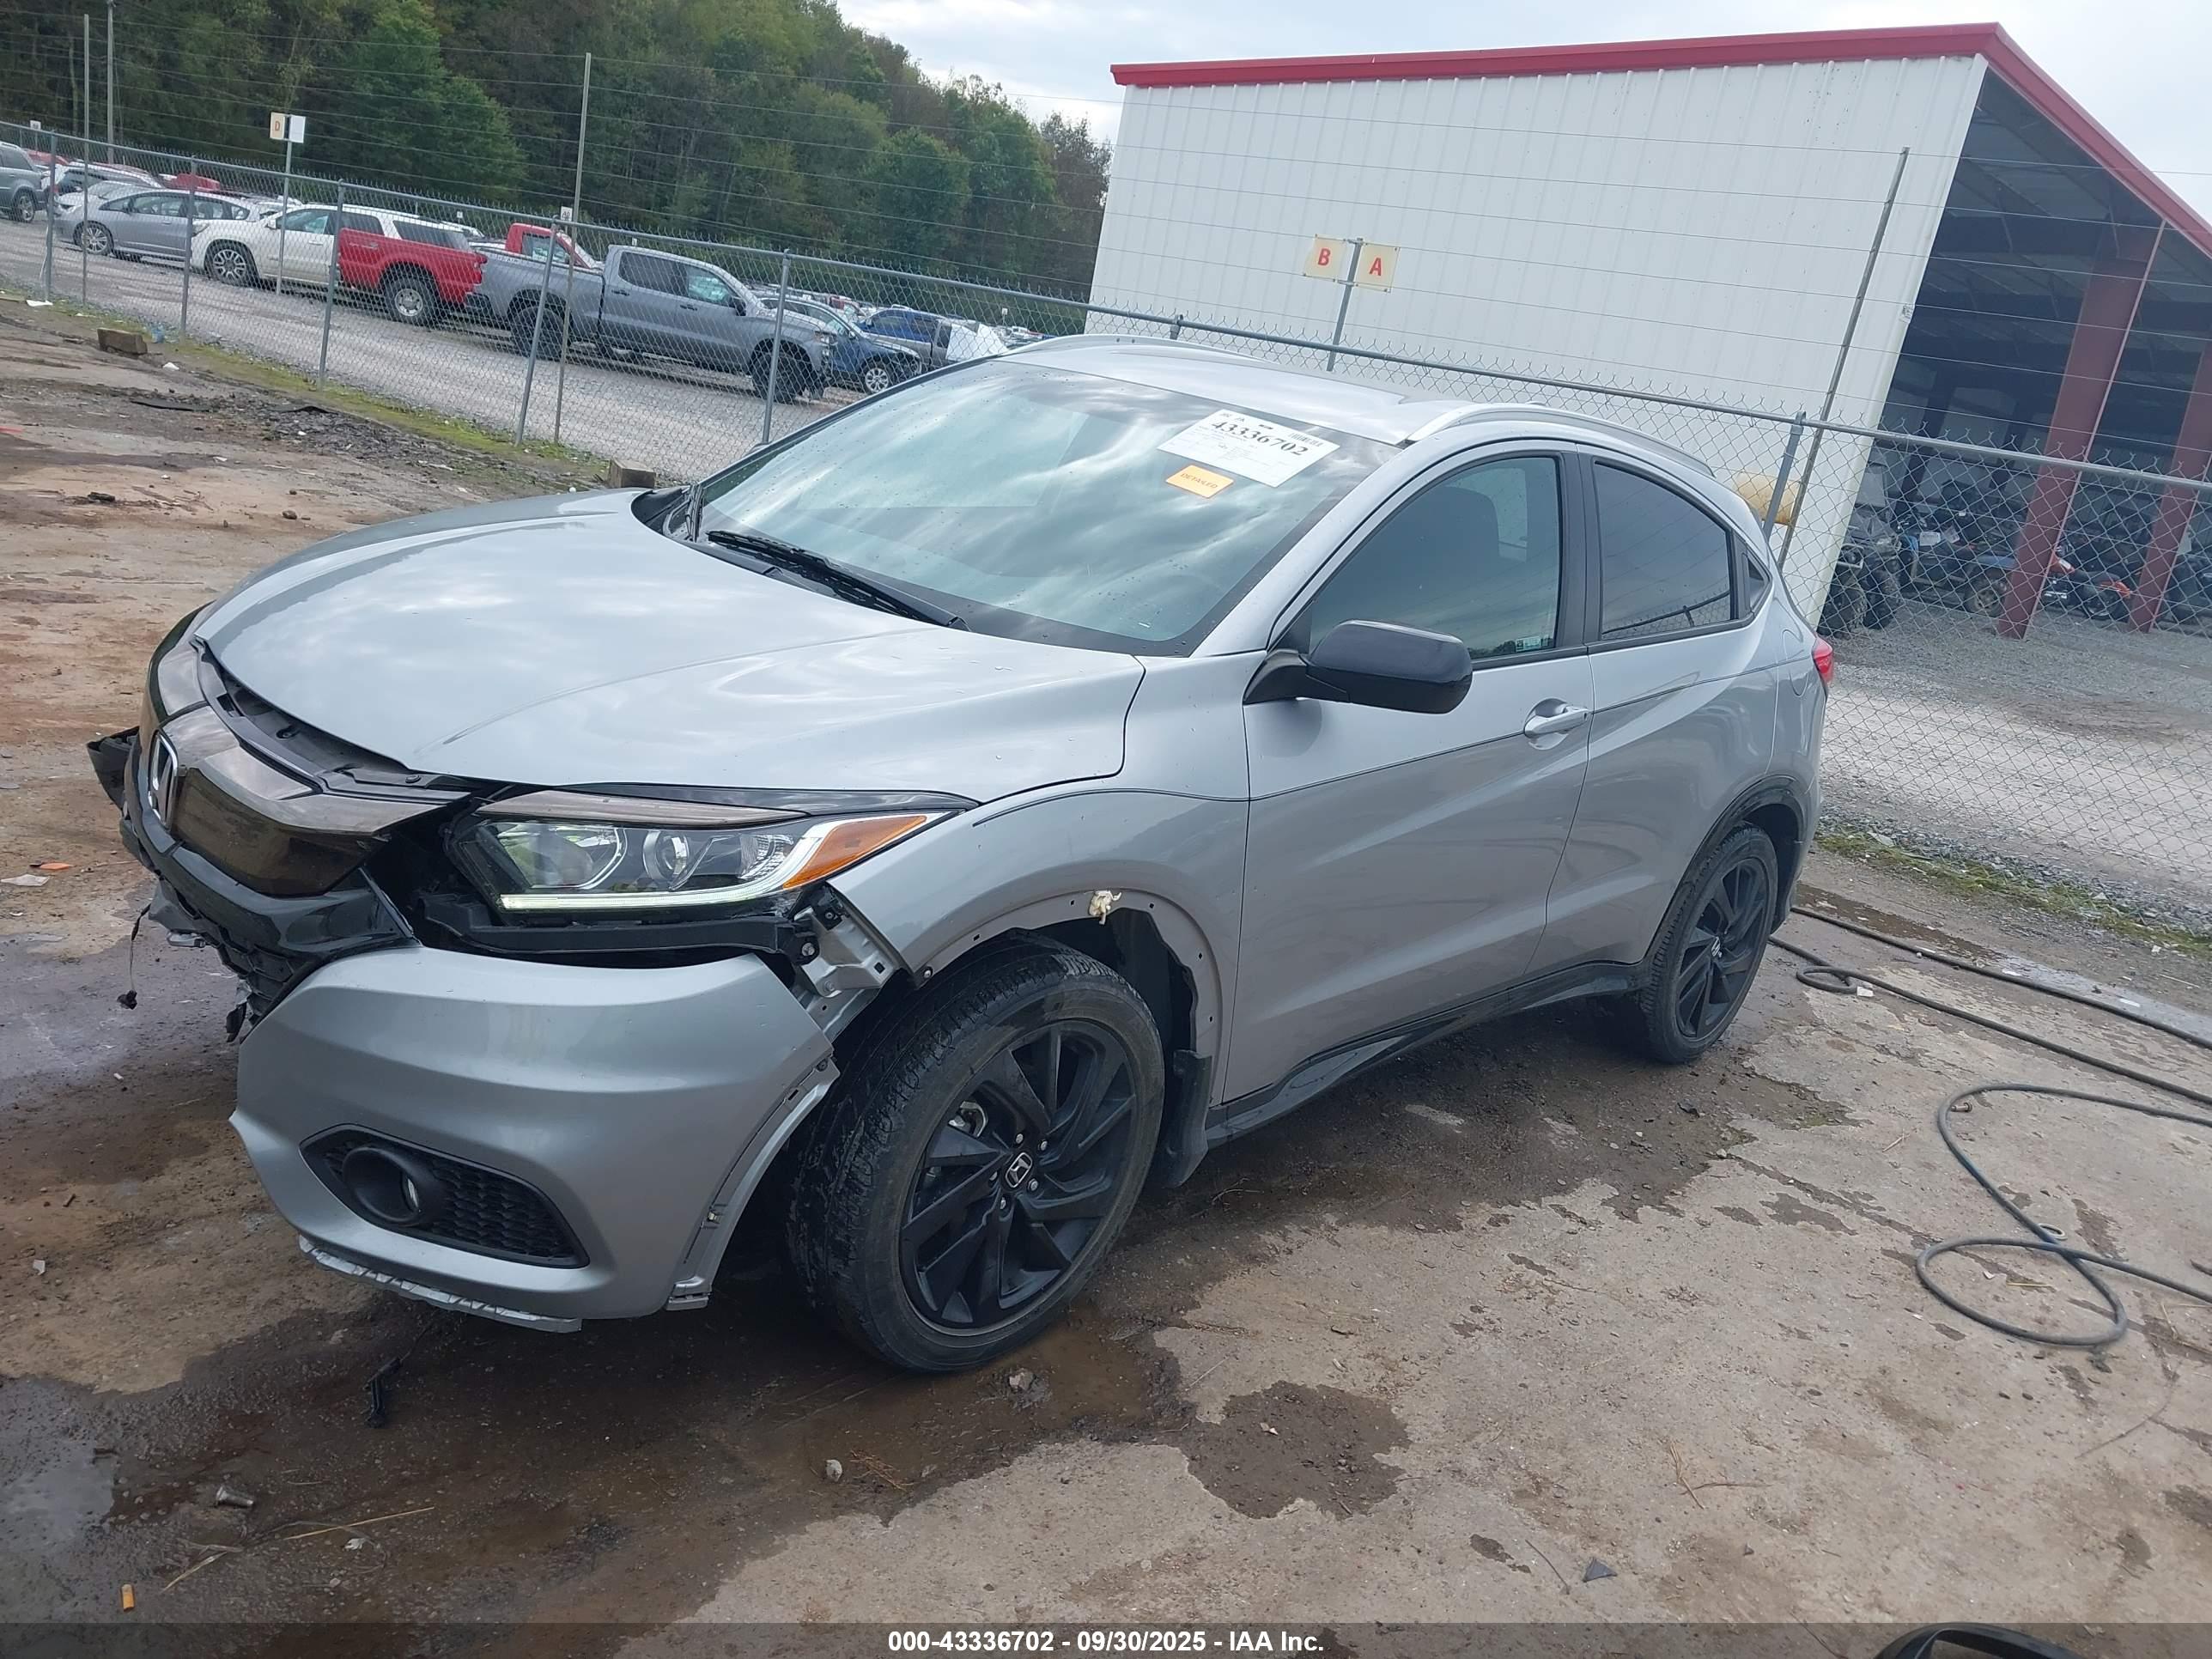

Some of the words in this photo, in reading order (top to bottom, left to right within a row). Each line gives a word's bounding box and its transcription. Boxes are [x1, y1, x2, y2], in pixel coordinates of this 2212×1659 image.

[274, 120, 281, 131] D
[1317, 247, 1332, 266] B
[1369, 257, 1382, 276] A
[1211, 421, 1309, 456] 43336702
